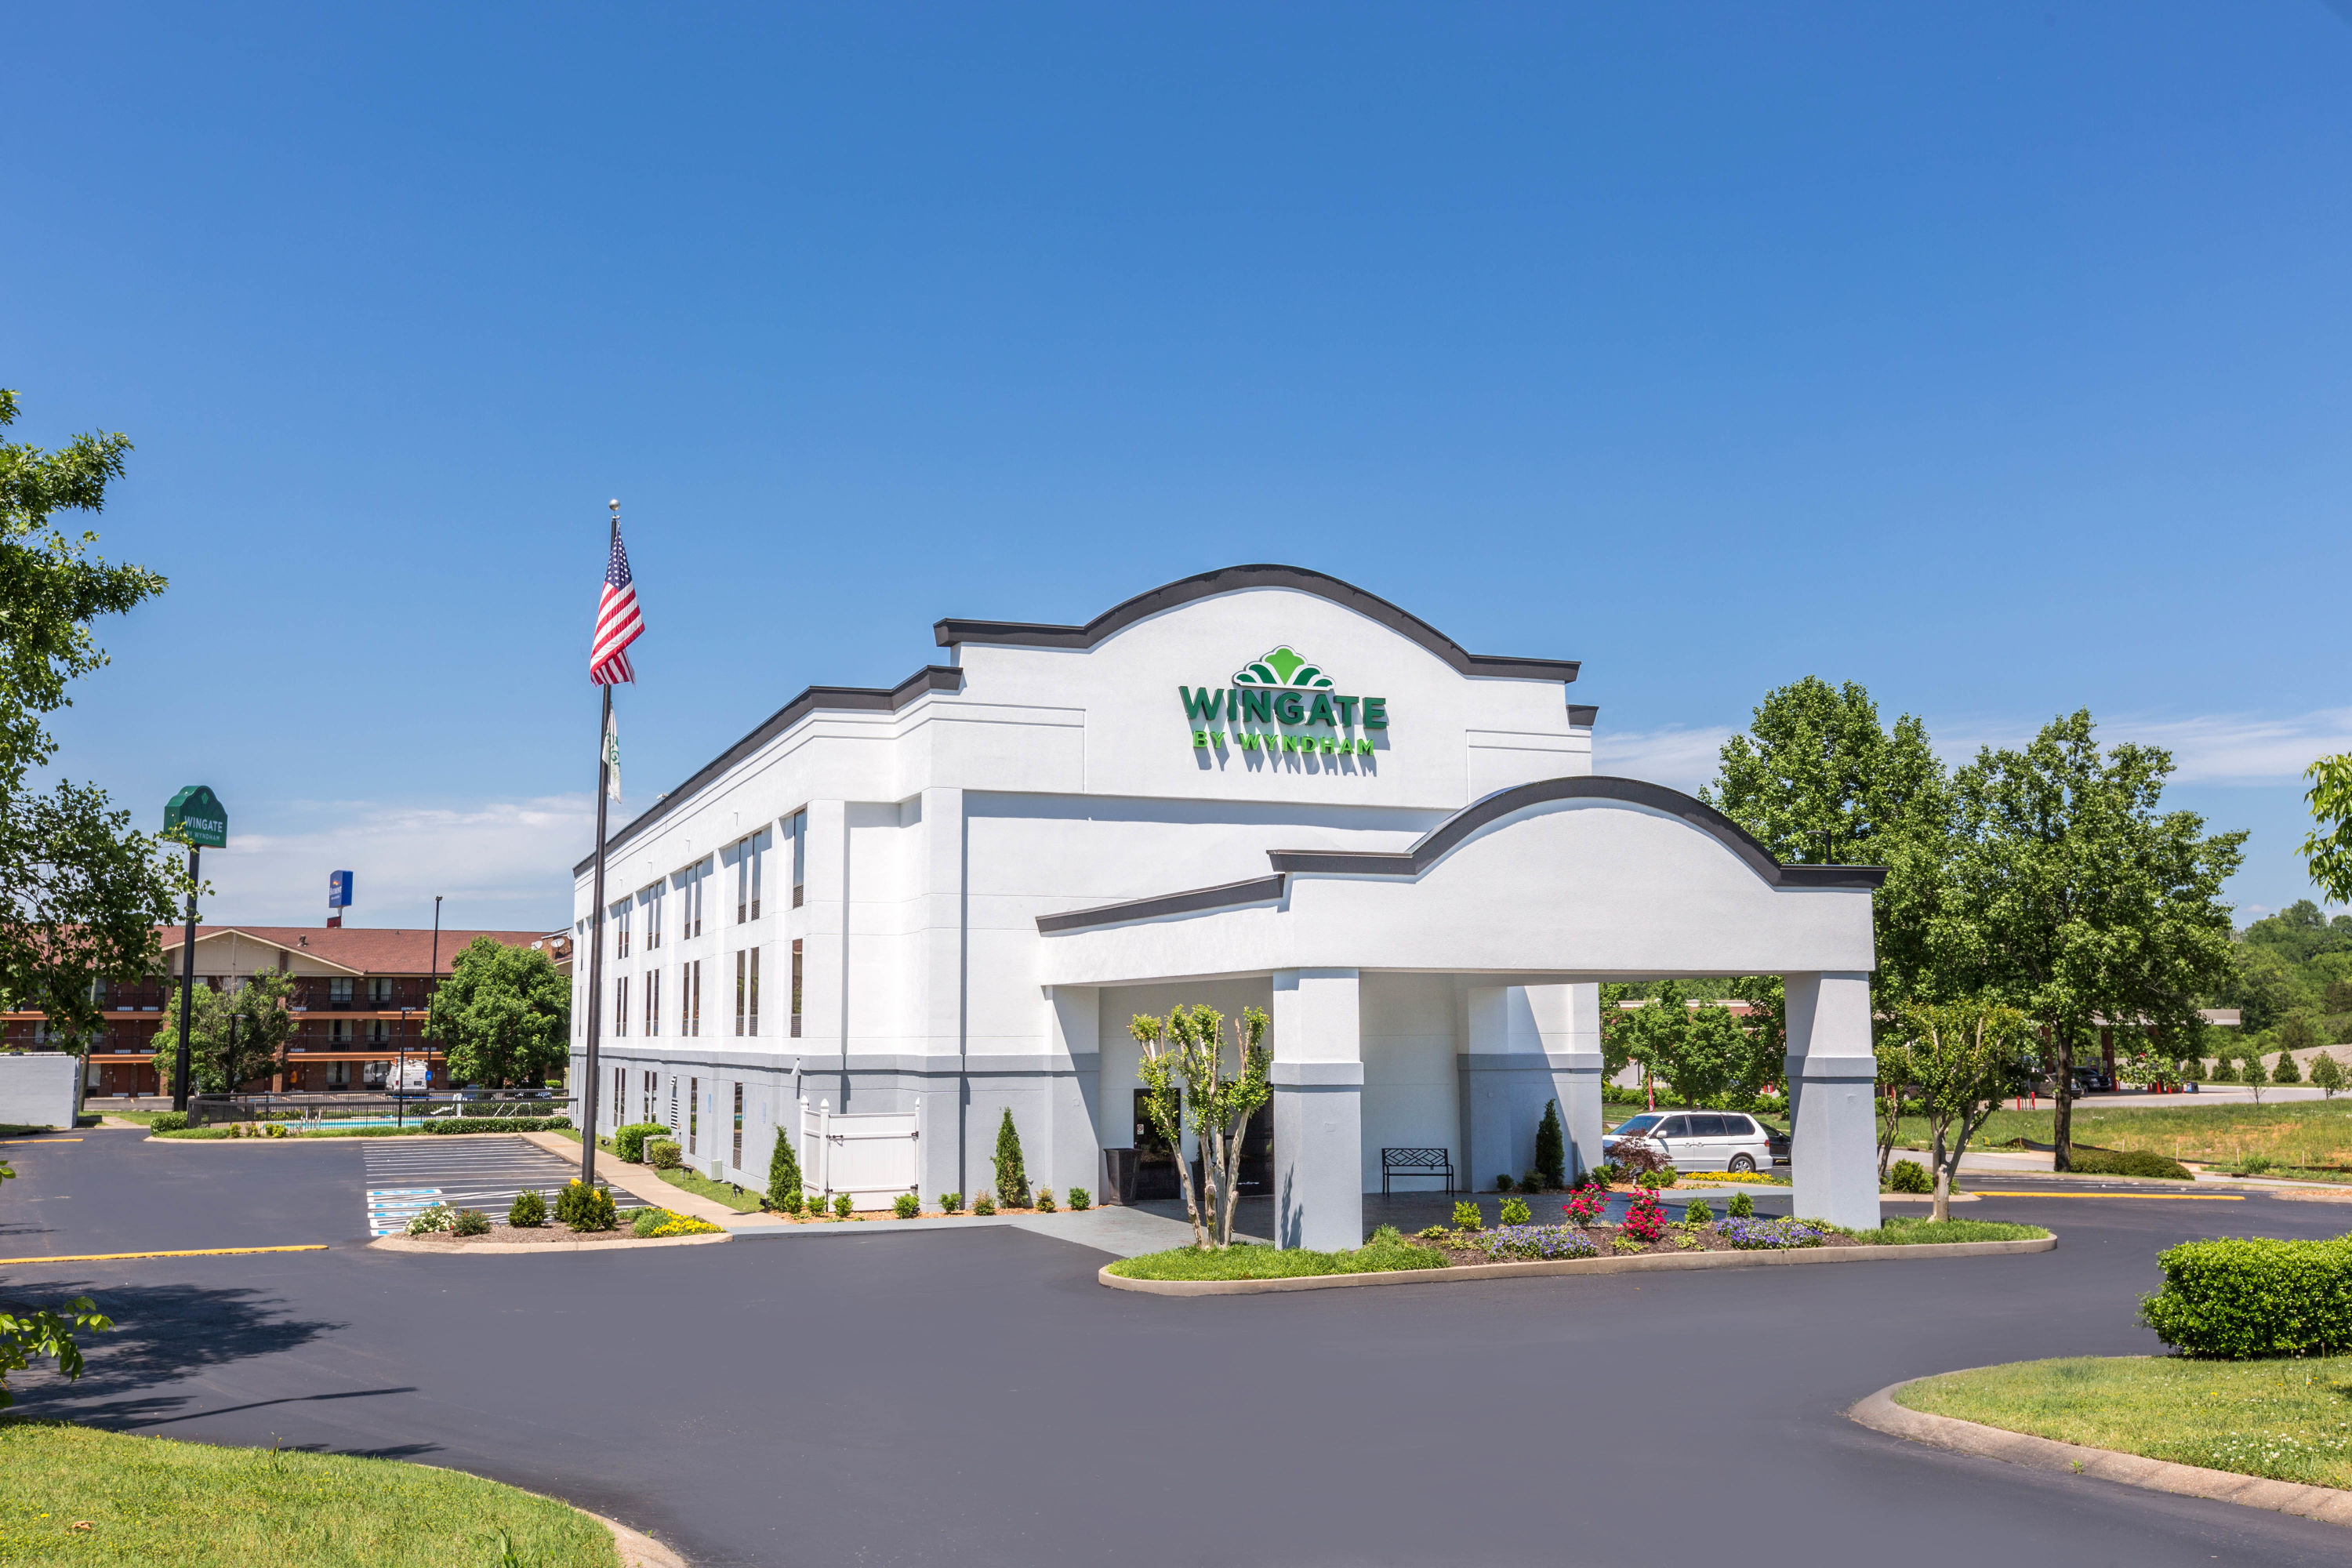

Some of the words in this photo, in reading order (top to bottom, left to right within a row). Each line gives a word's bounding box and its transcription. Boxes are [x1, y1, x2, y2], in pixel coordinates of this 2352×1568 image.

[1178, 686, 1388, 729] WINGATE
[1192, 730, 1226, 749] BY
[1238, 732, 1374, 756] WYNDHAM
[184, 815, 223, 833] WINGATE
[194, 832, 220, 840] WYNDHAM
